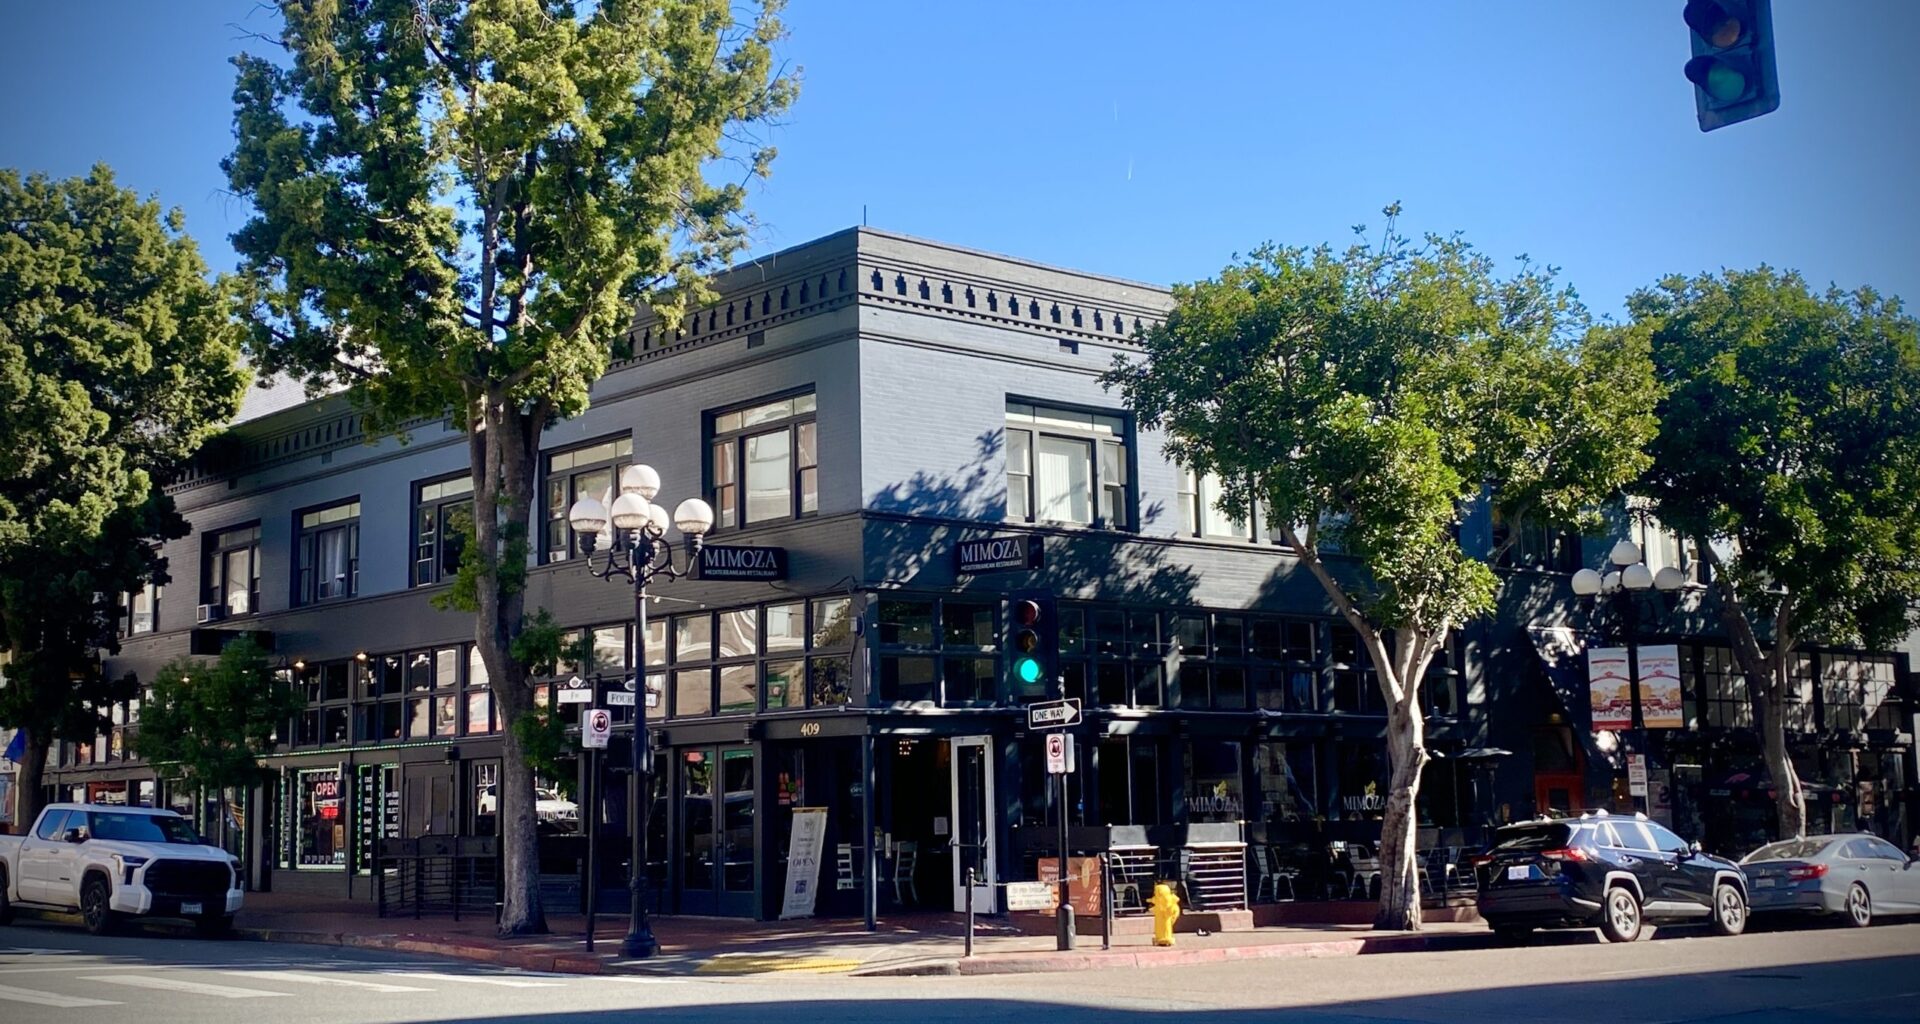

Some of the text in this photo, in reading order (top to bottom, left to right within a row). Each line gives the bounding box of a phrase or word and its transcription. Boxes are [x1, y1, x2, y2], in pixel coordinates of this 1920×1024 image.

[704, 549, 778, 568] MIMOZA
[961, 540, 1022, 563] MIMOZA
[1034, 708, 1065, 721] ONE WAY
[801, 723, 820, 736] 409
[316, 782, 338, 796] OPEN
[1189, 797, 1240, 813] MIMOZA
[1343, 796, 1387, 811] MIMOZA
[793, 858, 815, 867] OPEN
